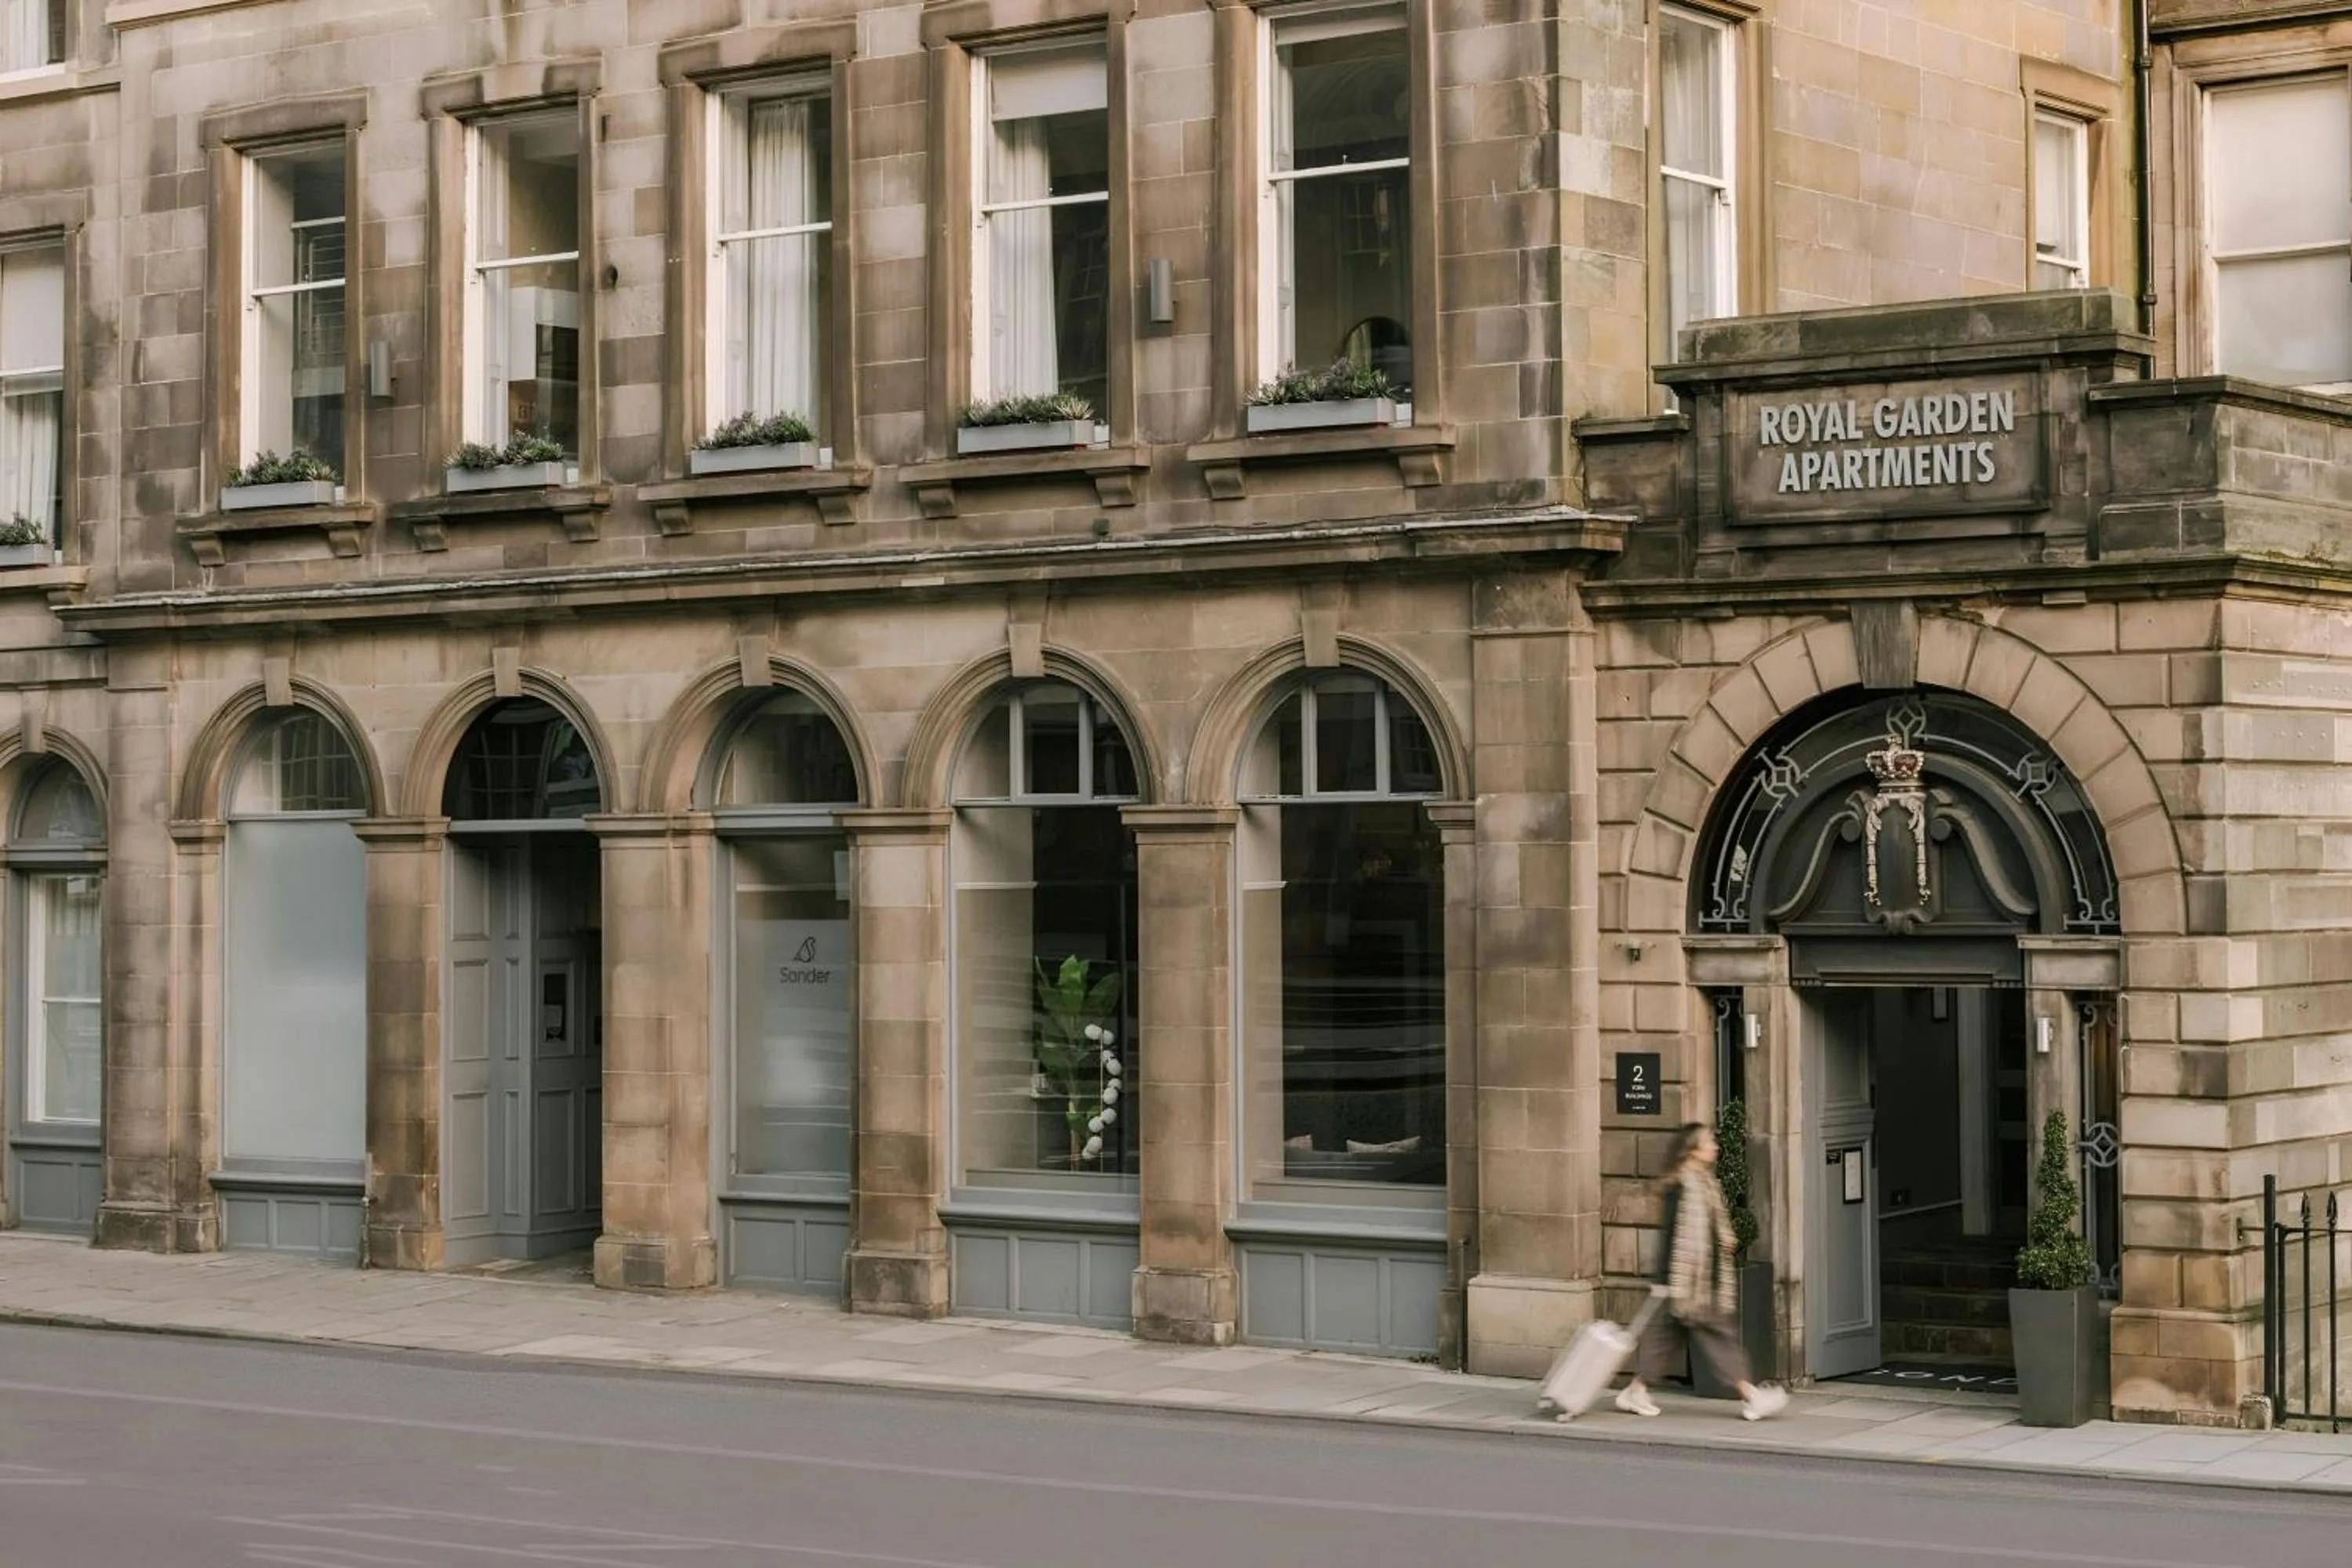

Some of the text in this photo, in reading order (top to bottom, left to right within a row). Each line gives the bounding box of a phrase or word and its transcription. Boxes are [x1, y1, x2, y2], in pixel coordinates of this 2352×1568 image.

[1760, 391, 2015, 445] ROYAL GARDEN
[1778, 441, 1996, 493] APARTMENTS
[780, 967, 829, 984] Sonder
[1633, 1065, 1643, 1082] 2
